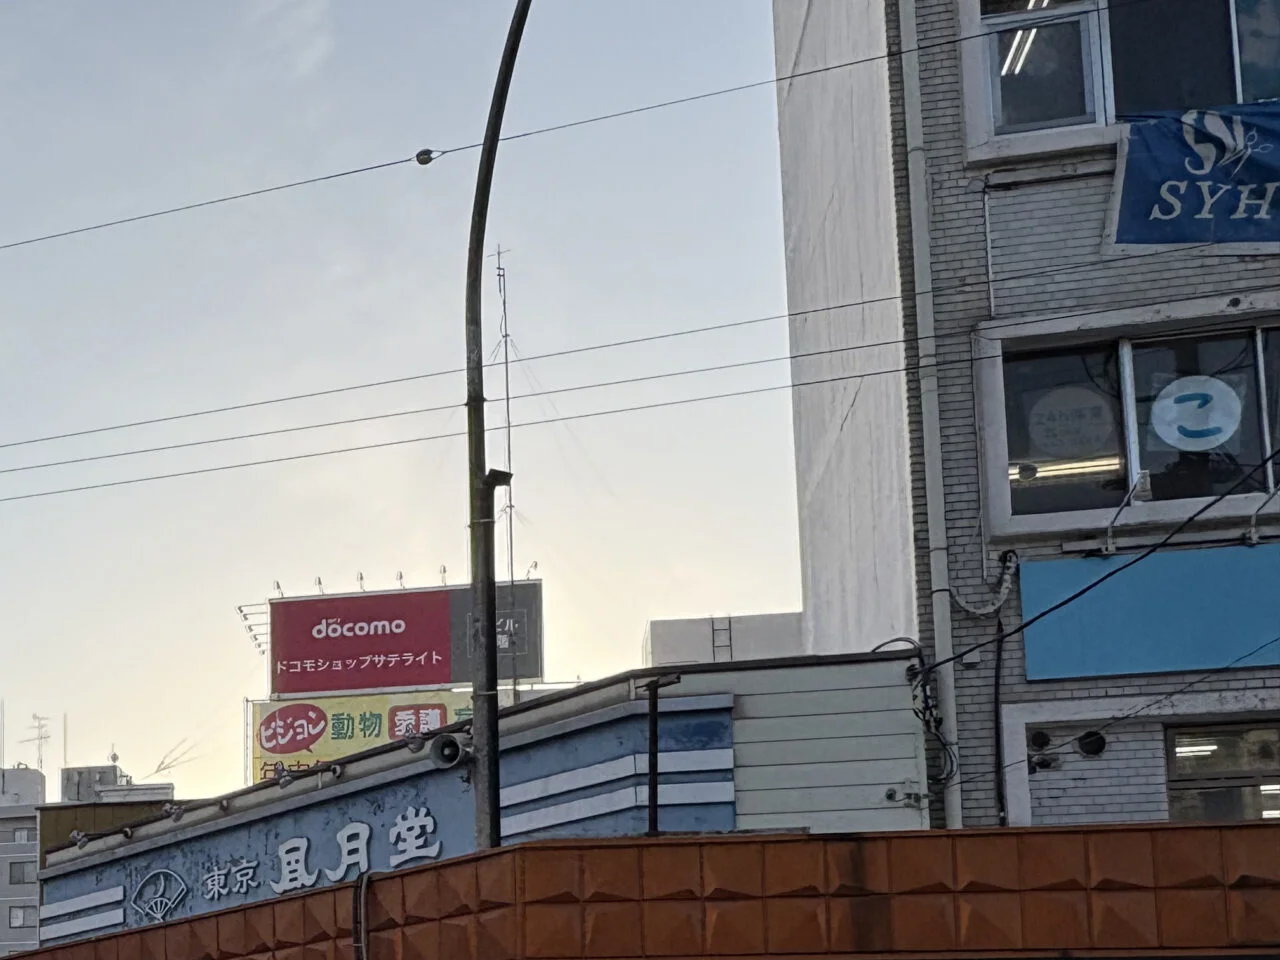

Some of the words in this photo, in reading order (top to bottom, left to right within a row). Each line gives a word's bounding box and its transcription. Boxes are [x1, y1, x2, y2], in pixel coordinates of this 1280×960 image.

[311, 617, 406, 640] docomo
[276, 650, 443, 675] ドコモショップサテライト
[331, 711, 383, 740] 動物
[202, 858, 260, 900] 東京
